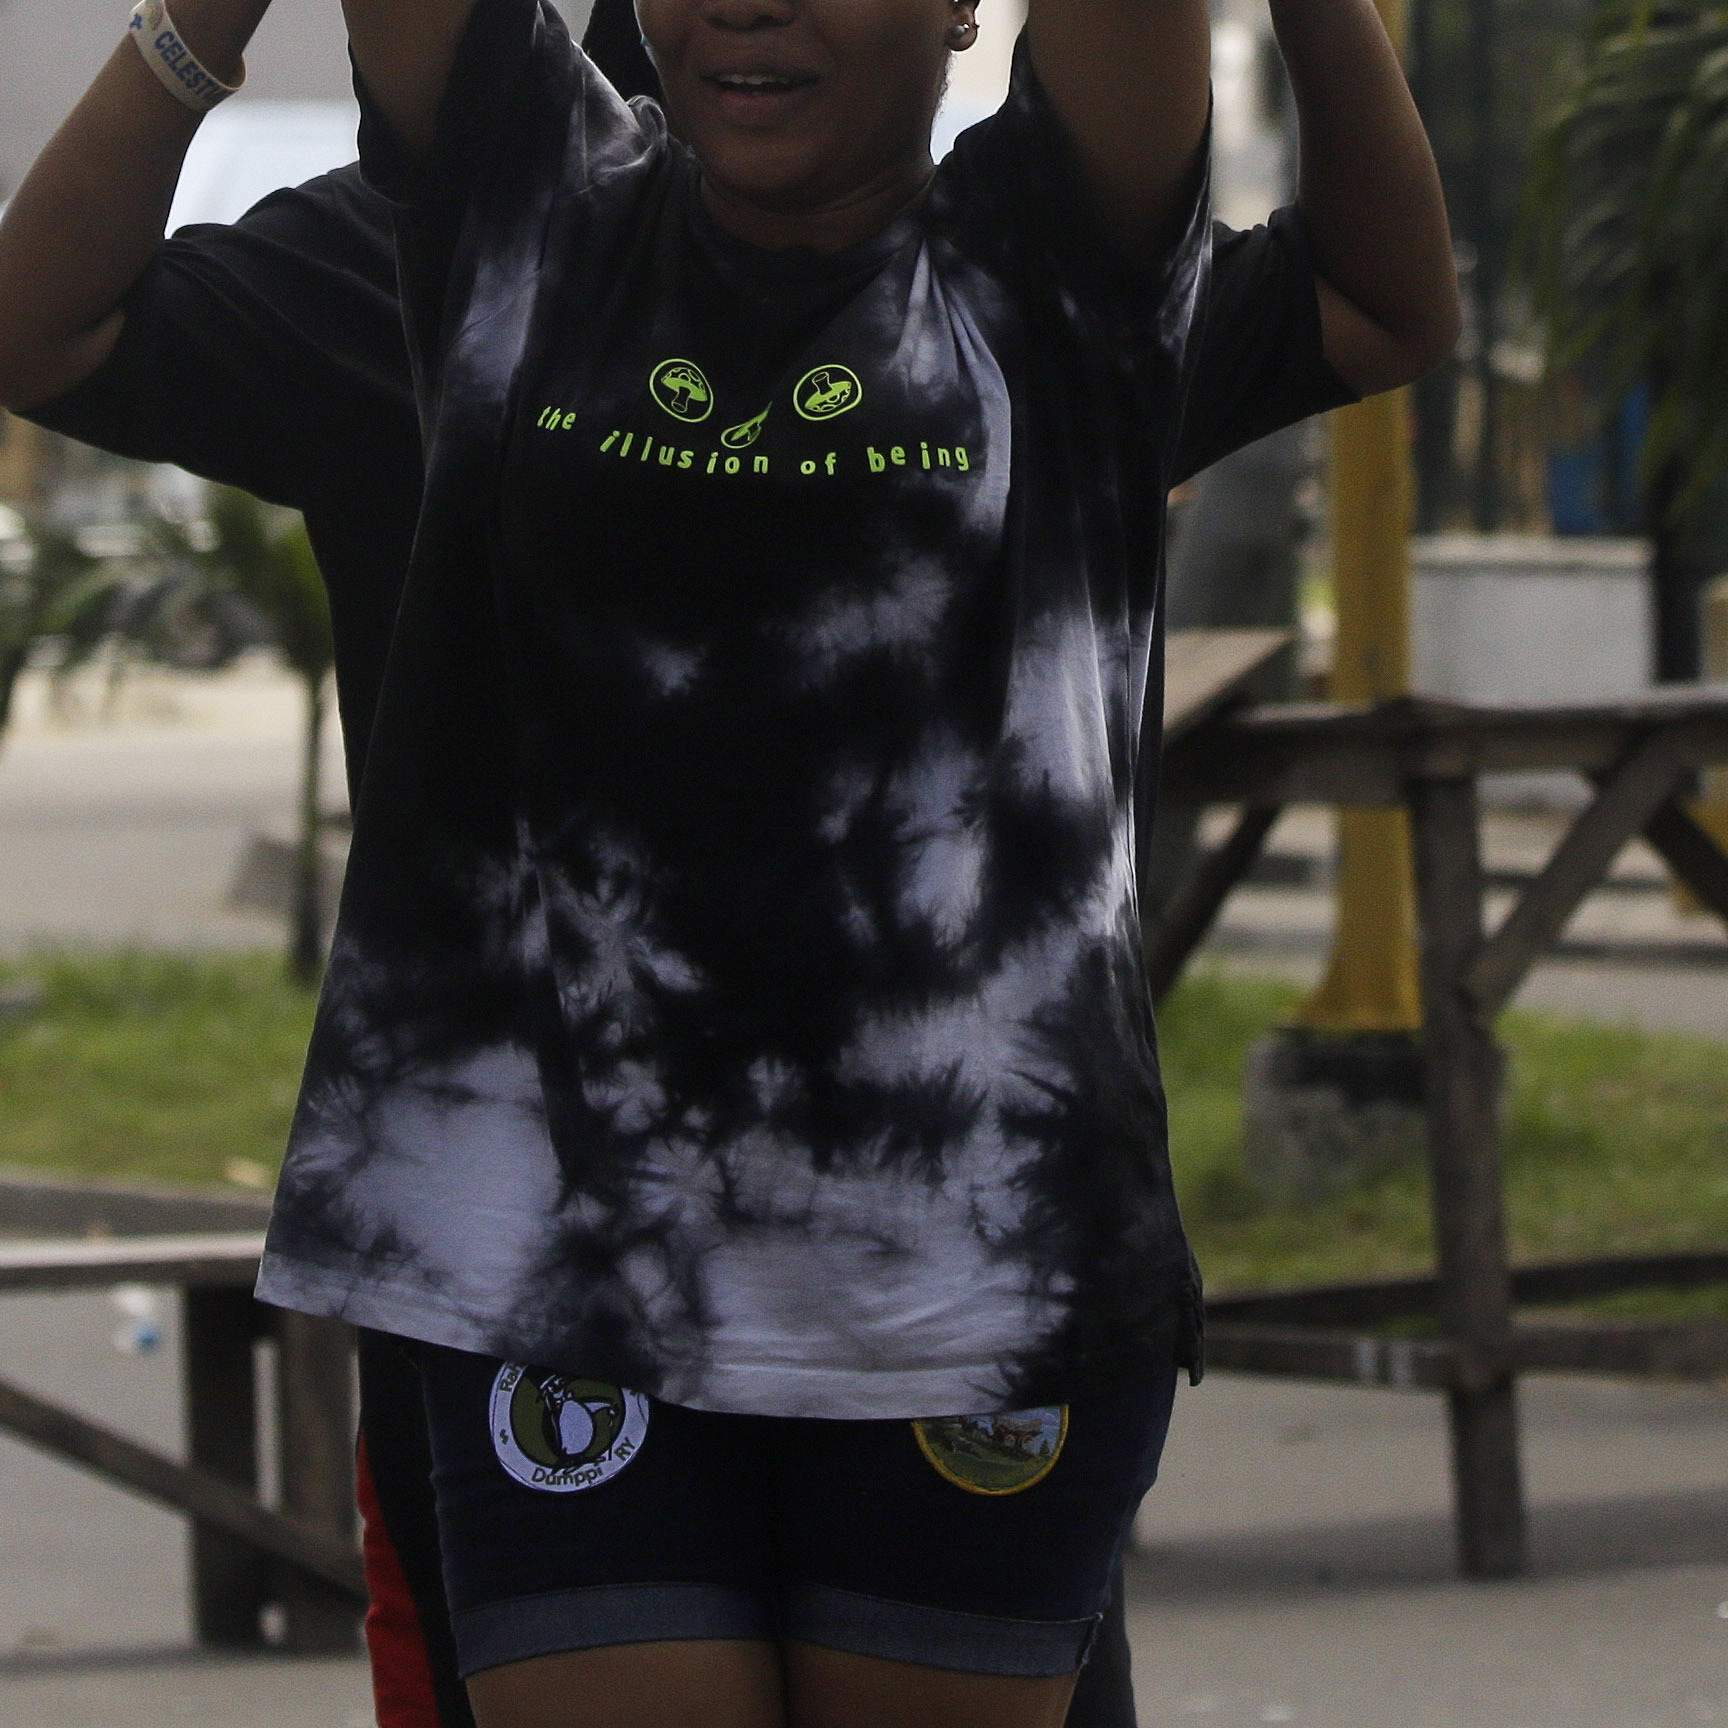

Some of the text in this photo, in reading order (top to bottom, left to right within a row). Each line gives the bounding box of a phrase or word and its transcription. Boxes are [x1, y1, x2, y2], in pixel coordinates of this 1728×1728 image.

[537, 406, 970, 475] the illusion of being
[531, 1436, 636, 1487] Dumppi RY
